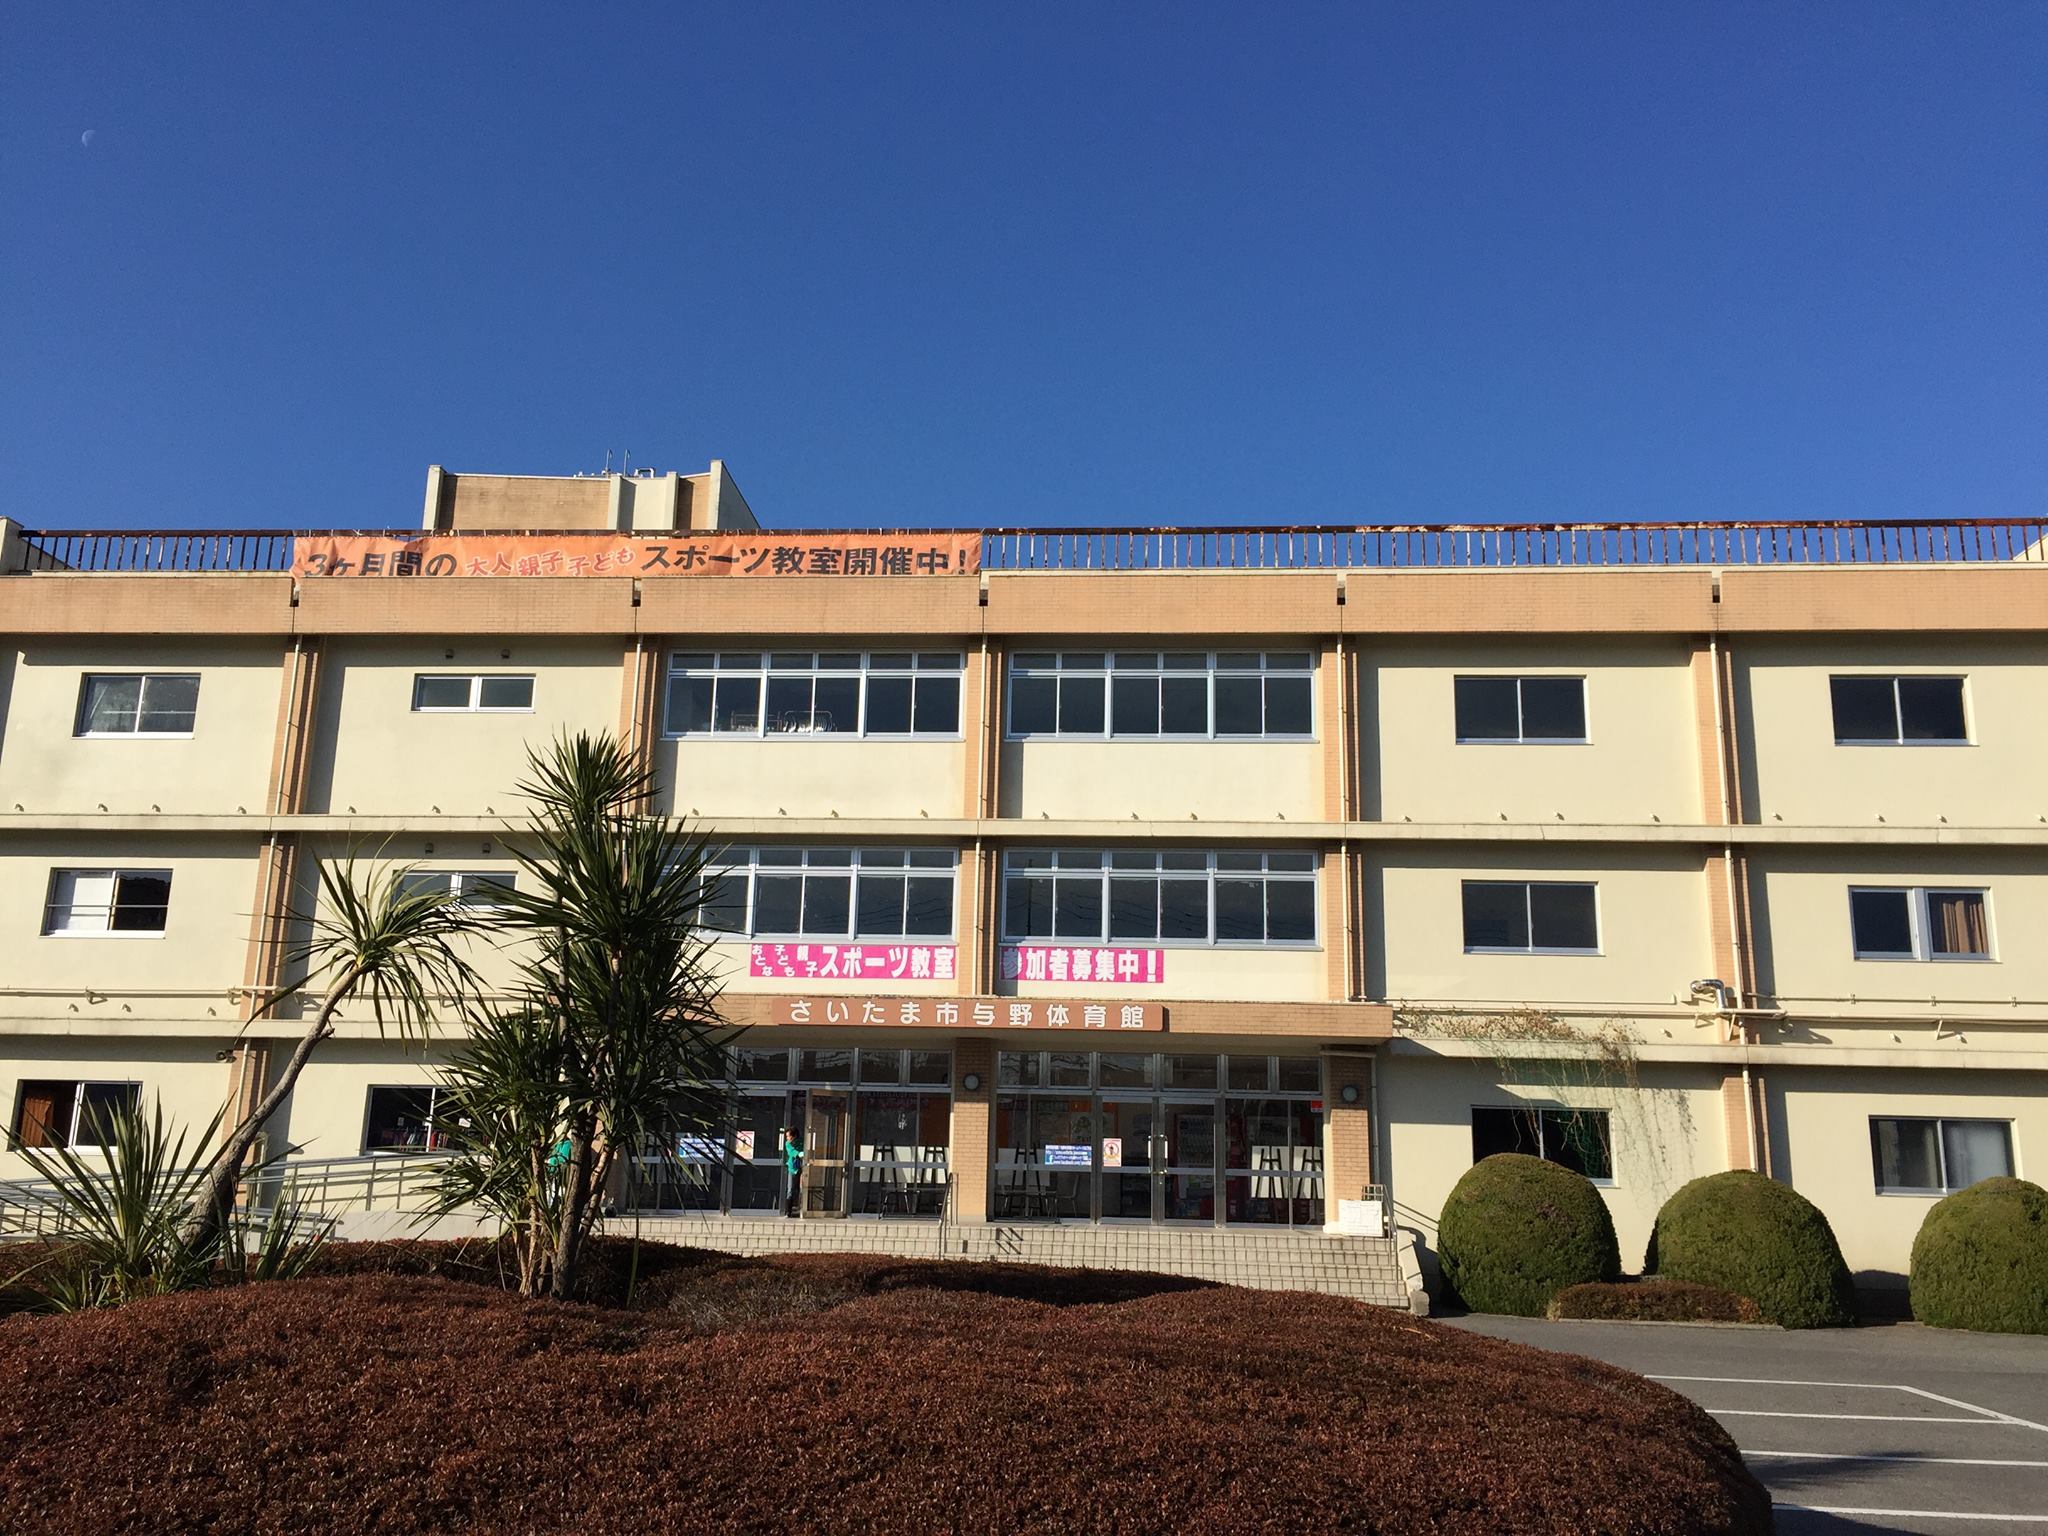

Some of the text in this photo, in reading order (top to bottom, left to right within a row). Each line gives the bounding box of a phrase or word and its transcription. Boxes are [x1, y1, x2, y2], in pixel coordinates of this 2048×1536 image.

[819, 946, 954, 978] スポーツ教室
[1003, 949, 1157, 982] 参加者募集中!
[790, 1000, 1144, 1028] さいたま市与野体育館
